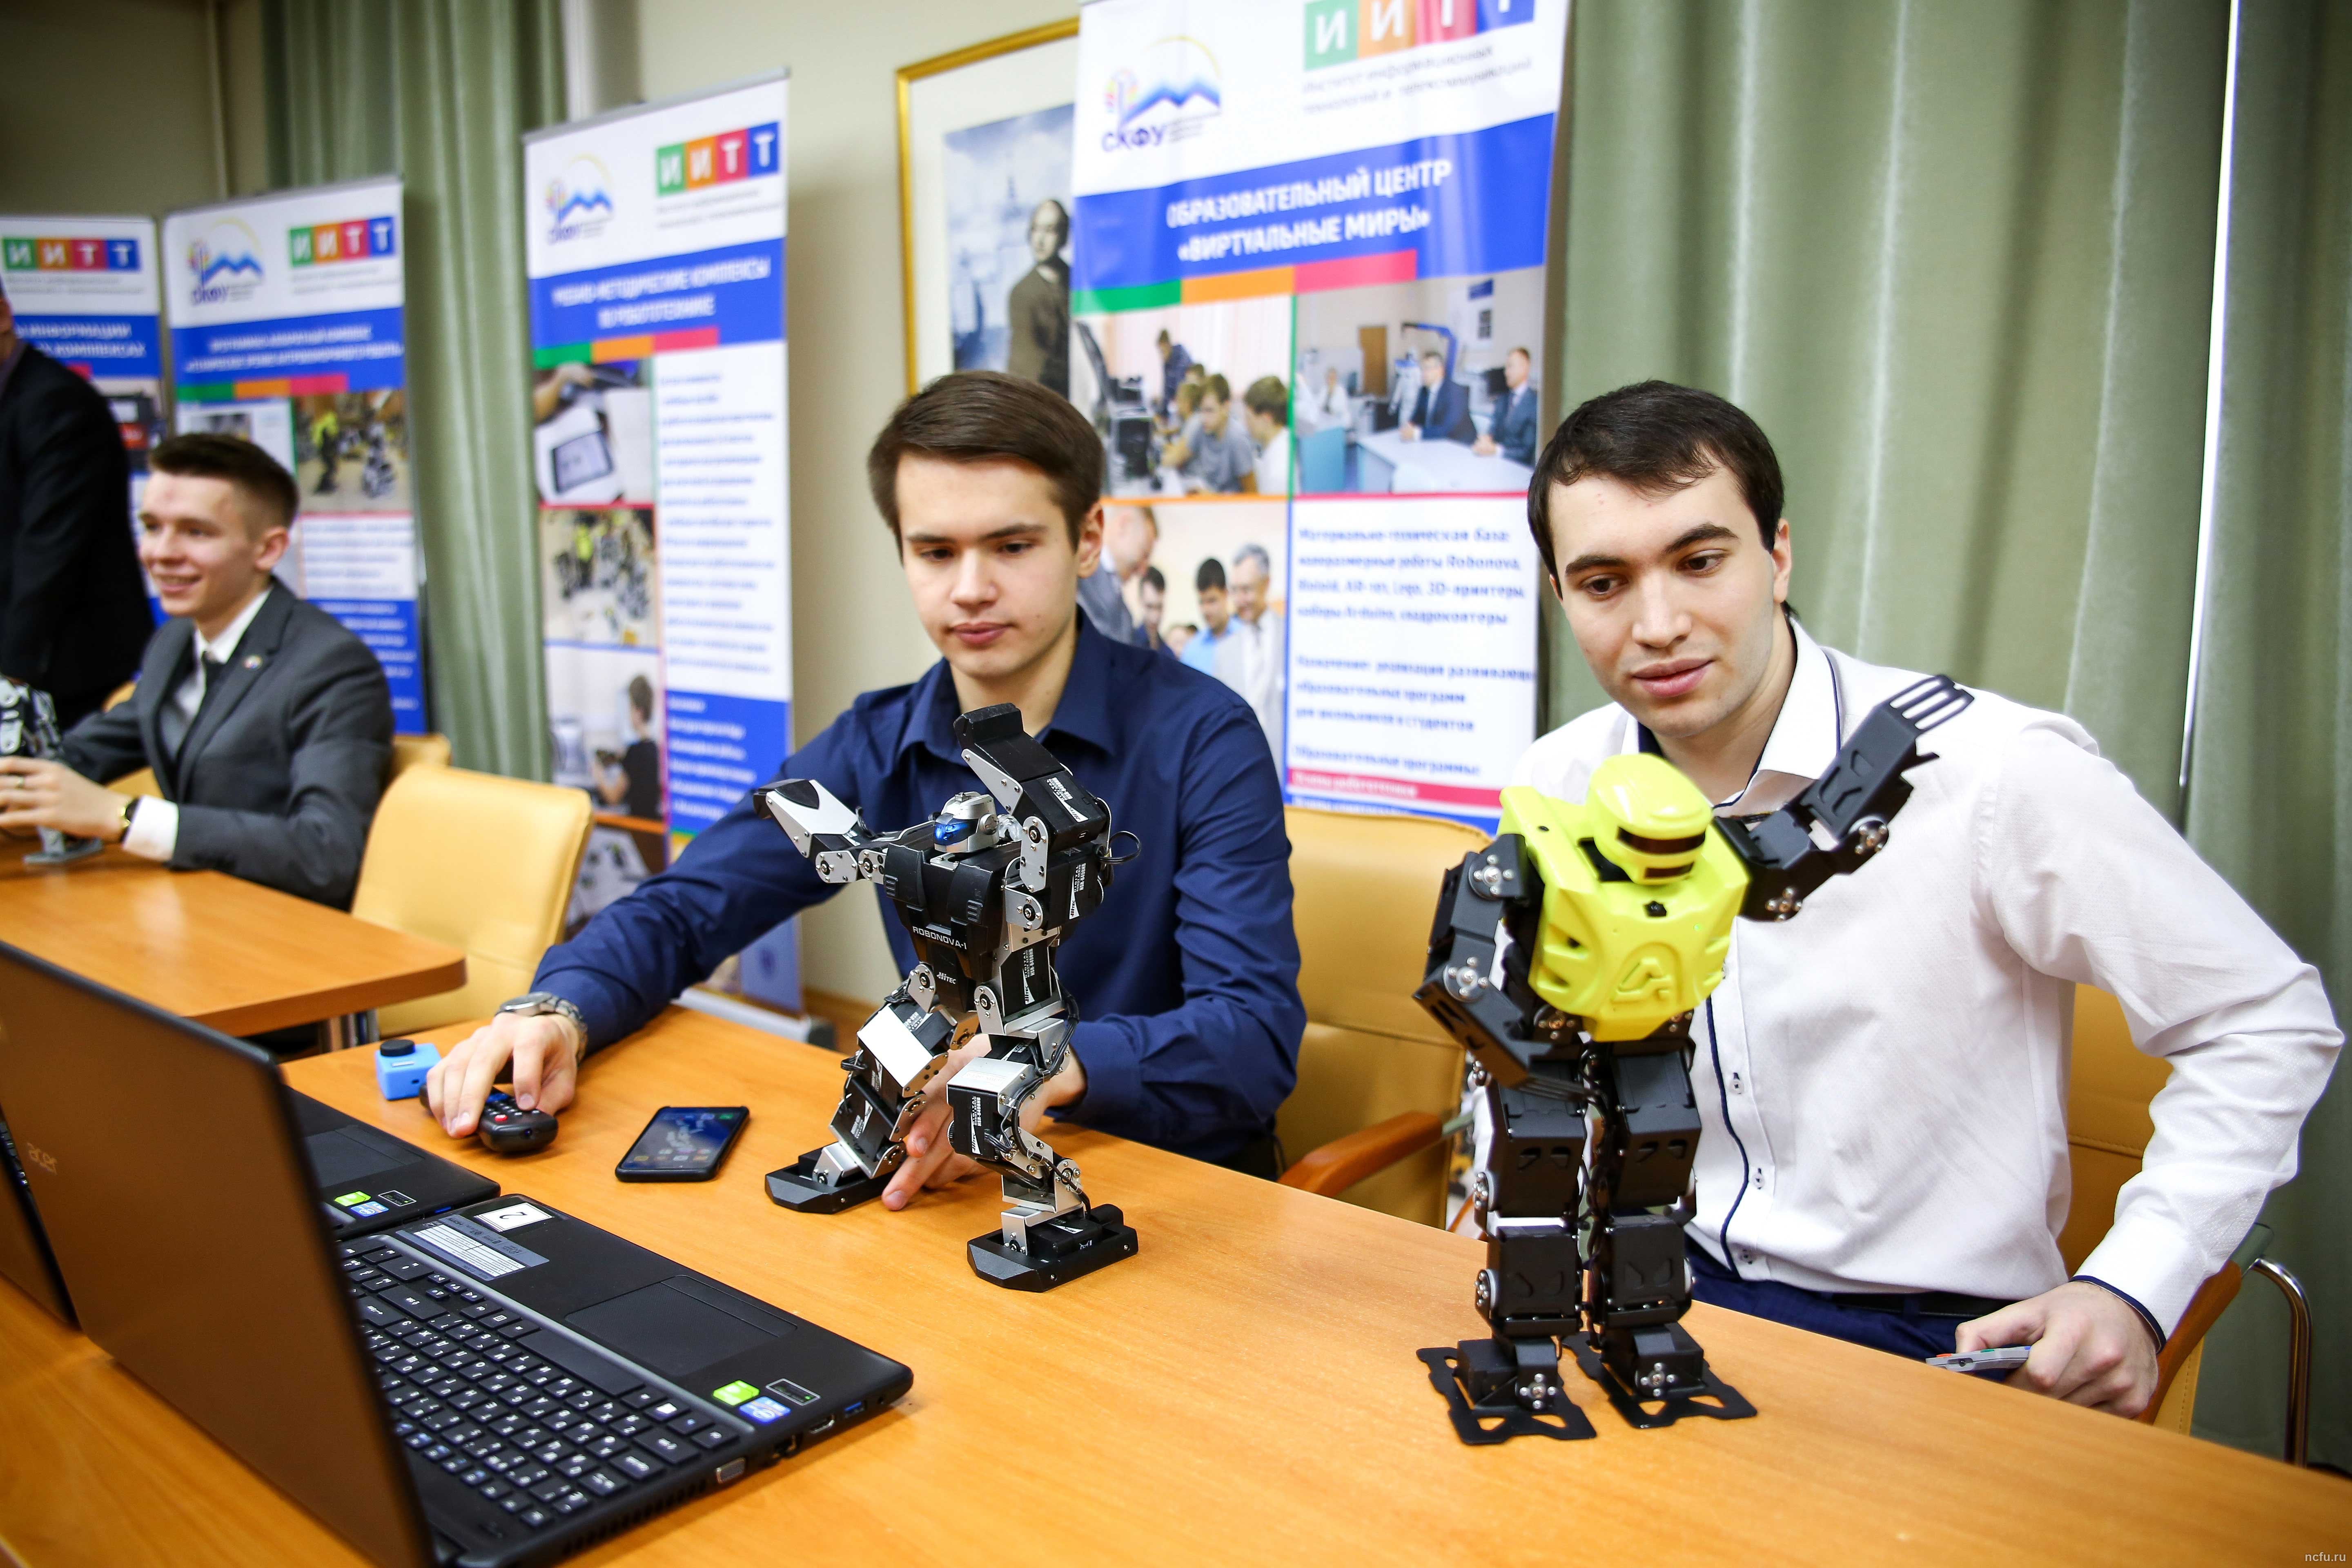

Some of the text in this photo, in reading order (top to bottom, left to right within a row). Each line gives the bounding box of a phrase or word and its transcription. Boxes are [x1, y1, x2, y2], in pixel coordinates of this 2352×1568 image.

[1316, 0, 1511, 54] ИИТ
[1102, 122, 1168, 153] СКФУ
[661, 132, 775, 187] ИИТТ
[1166, 158, 1452, 229] ОБРАЗОВАТЕЛЬНЫЙ ЦЕНТР
[293, 223, 389, 261] ИИТТ
[1177, 203, 1431, 264] «ВИРТУАЛЬНЫЕ МИРЫ»
[7, 244, 131, 265] ИИТТ
[1474, 526, 1510, 543] база:
[1447, 554, 1521, 571] Robonova,
